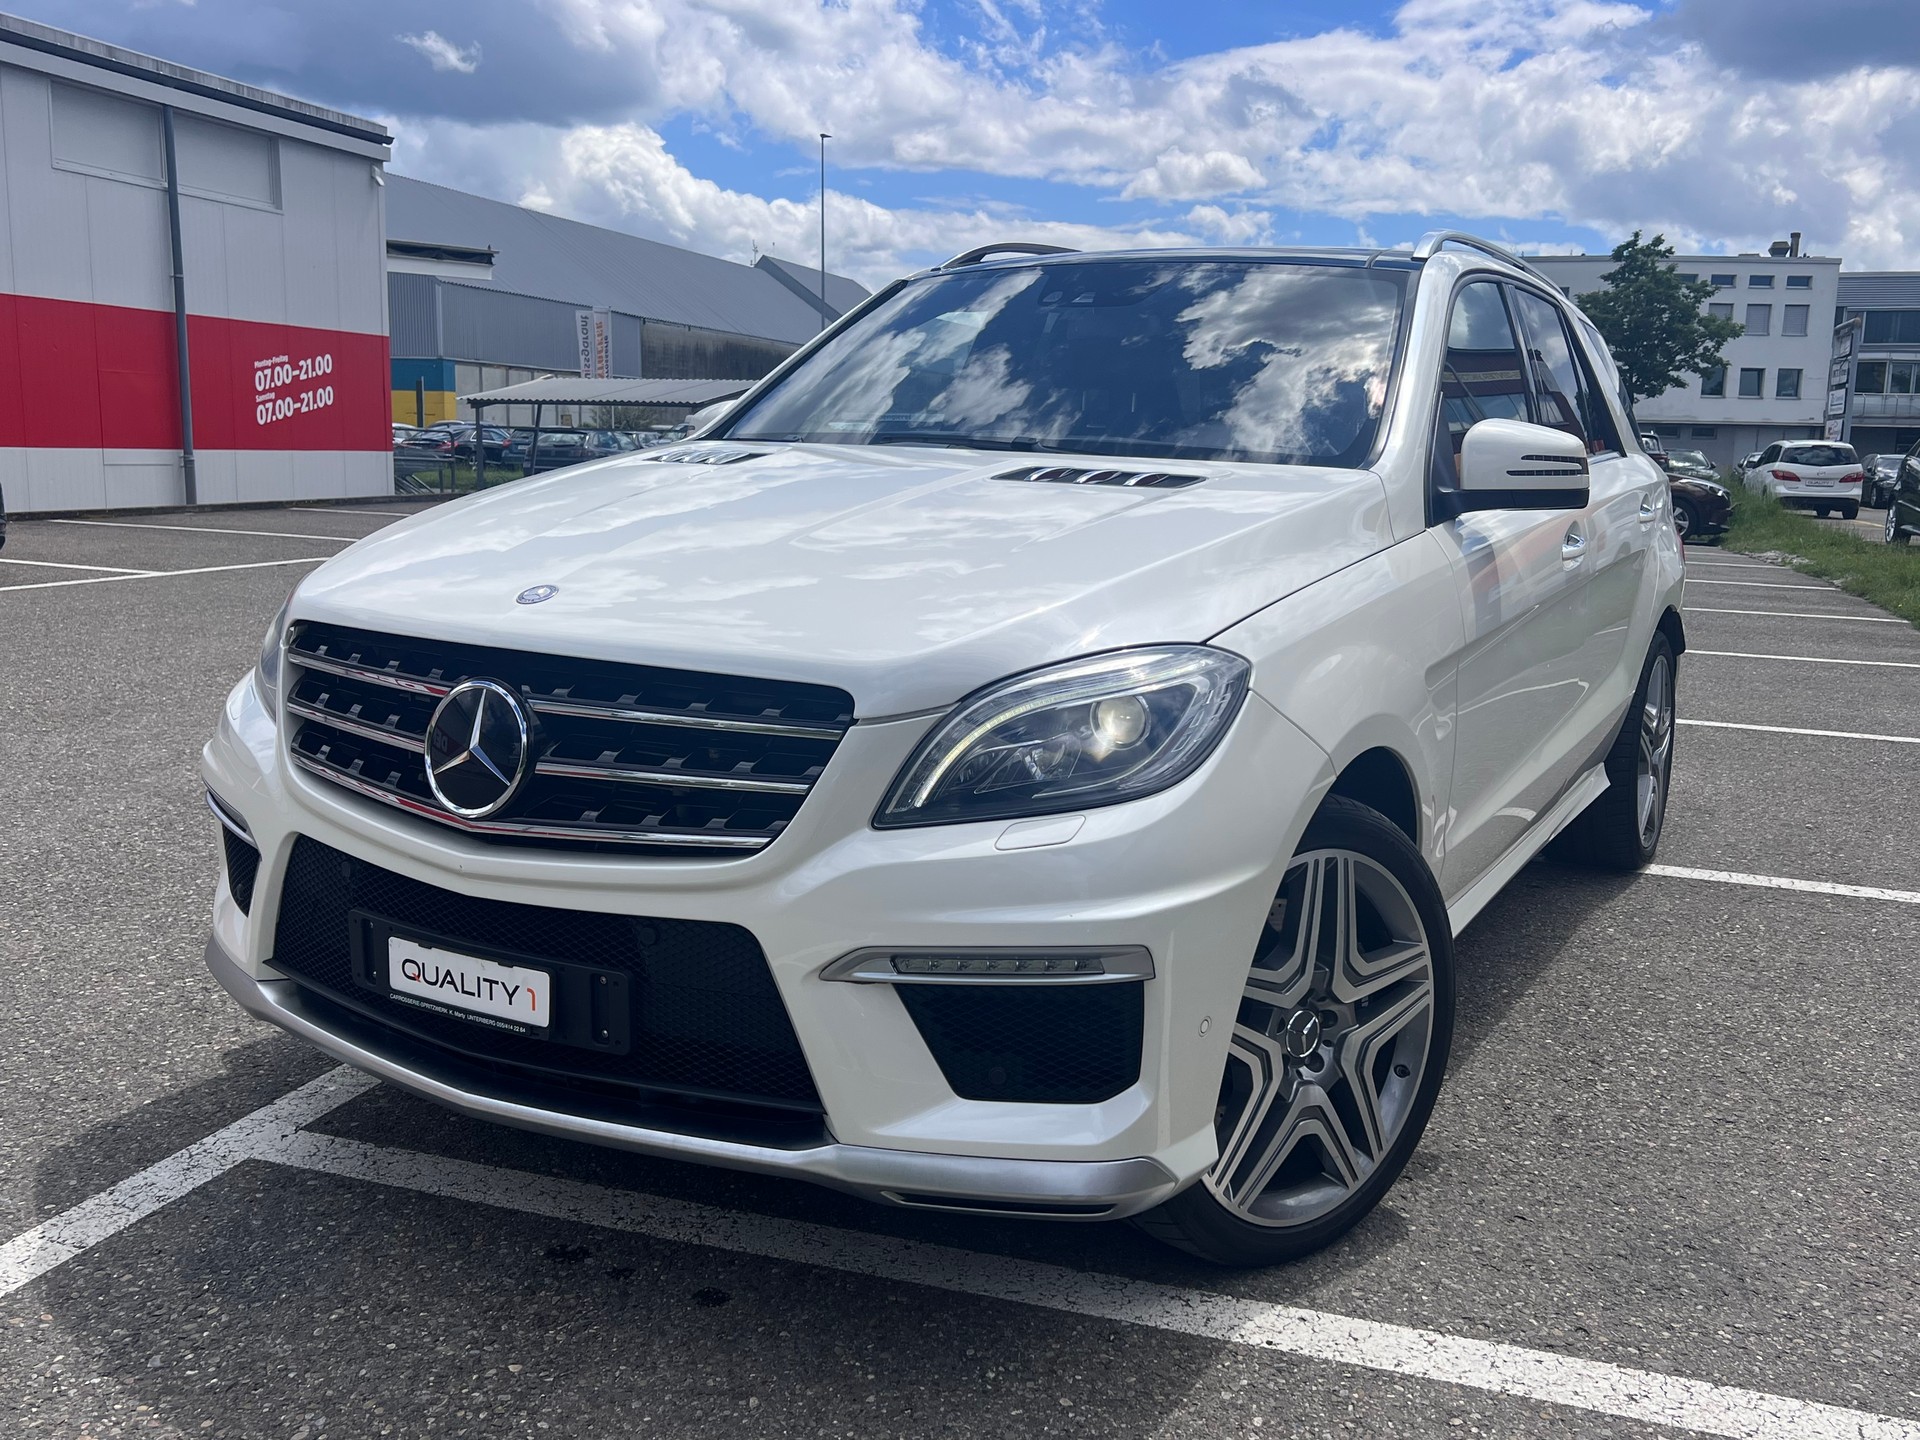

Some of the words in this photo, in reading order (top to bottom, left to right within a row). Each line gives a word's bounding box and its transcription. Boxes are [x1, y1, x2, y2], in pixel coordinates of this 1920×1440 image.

[256, 391, 275, 403] Samstag
[401, 958, 520, 1005] QUALITY
[526, 987, 536, 1011] 1
